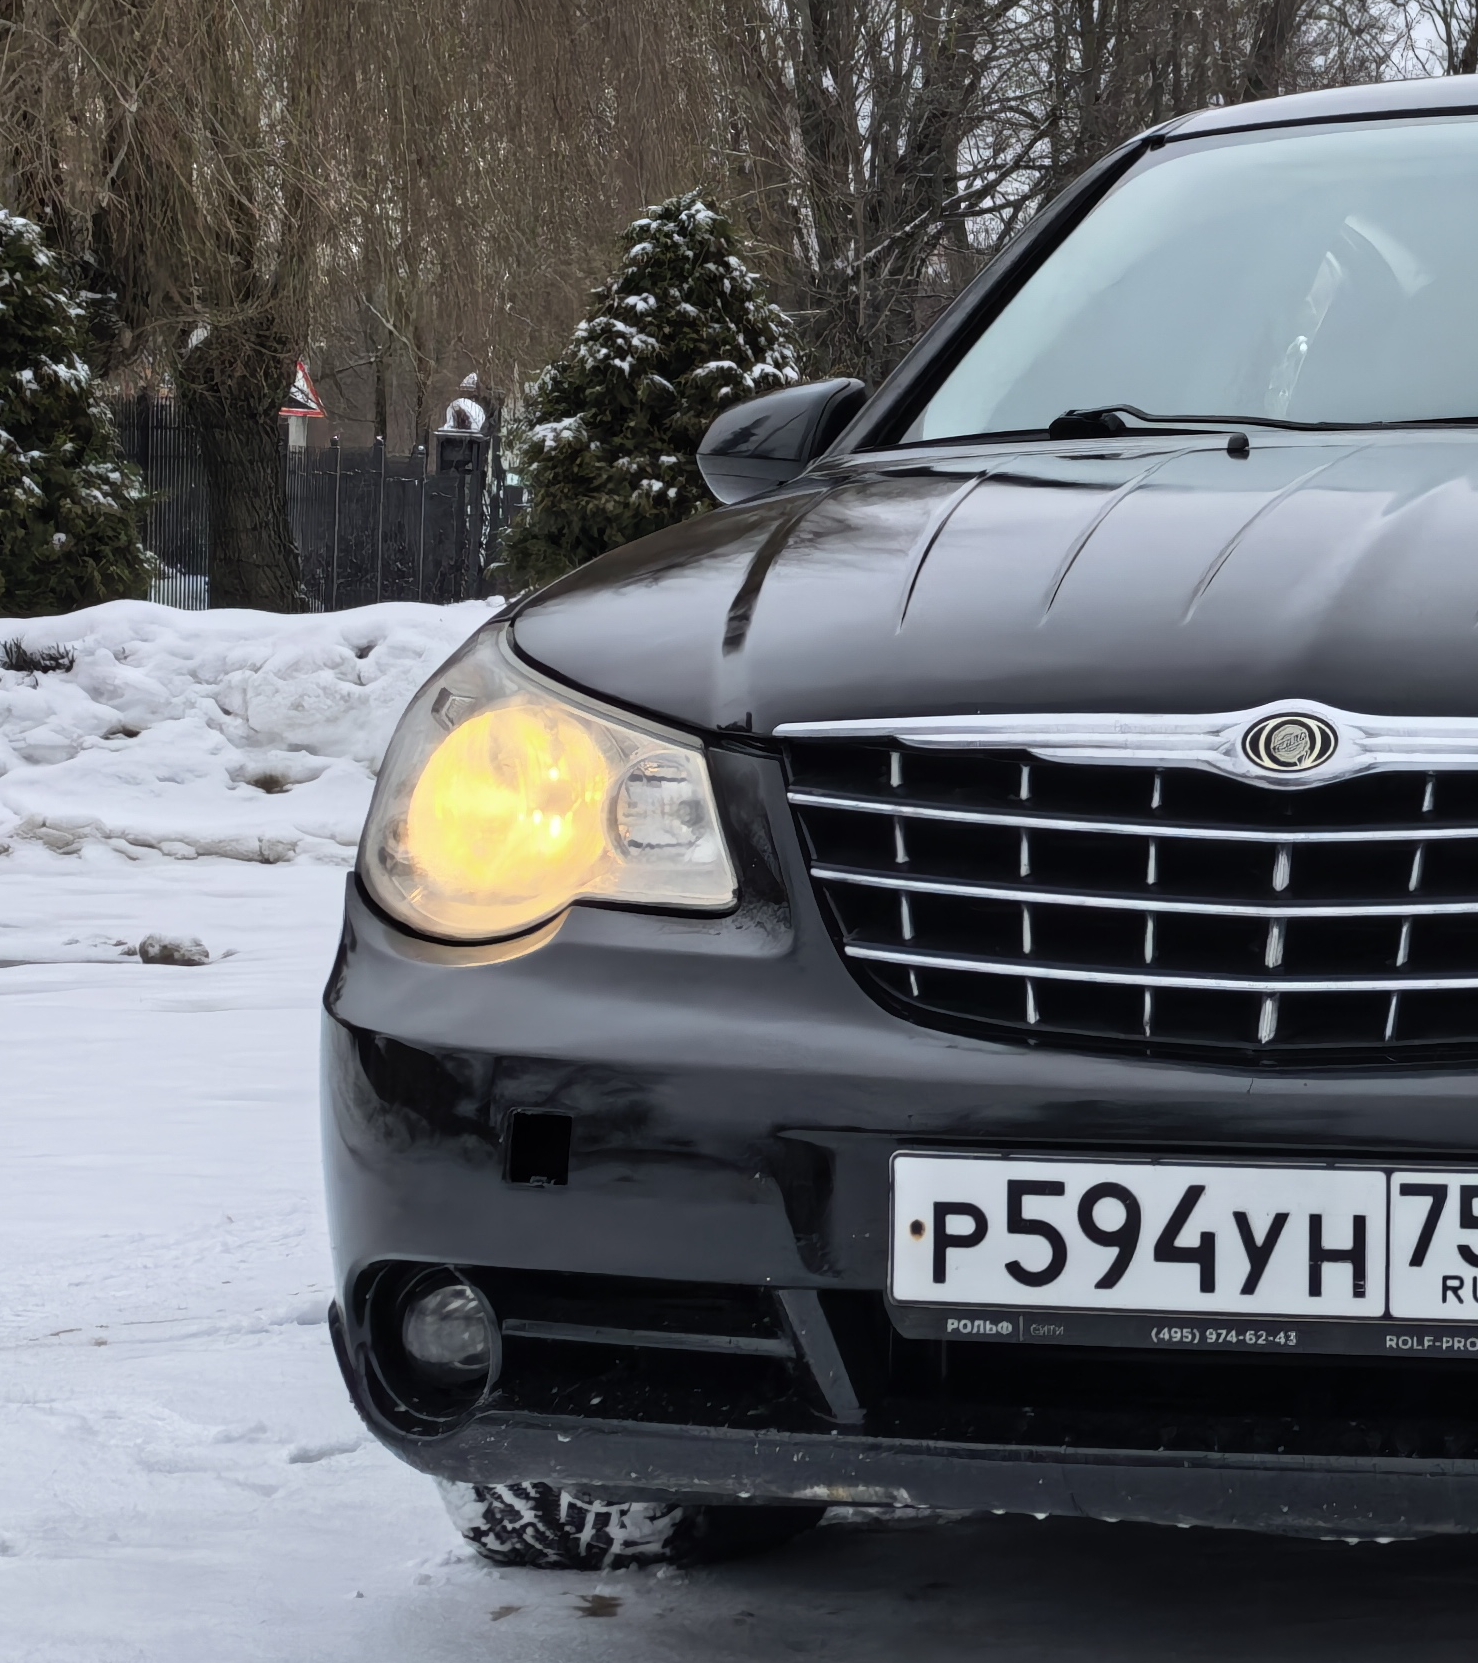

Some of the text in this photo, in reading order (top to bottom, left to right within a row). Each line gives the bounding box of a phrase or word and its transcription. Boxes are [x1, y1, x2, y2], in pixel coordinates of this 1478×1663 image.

[932, 1179, 1367, 1298] Р594УН
[946, 1318, 1013, 1336] РОЛЬФ
[1150, 1327, 1201, 1344] (495)
